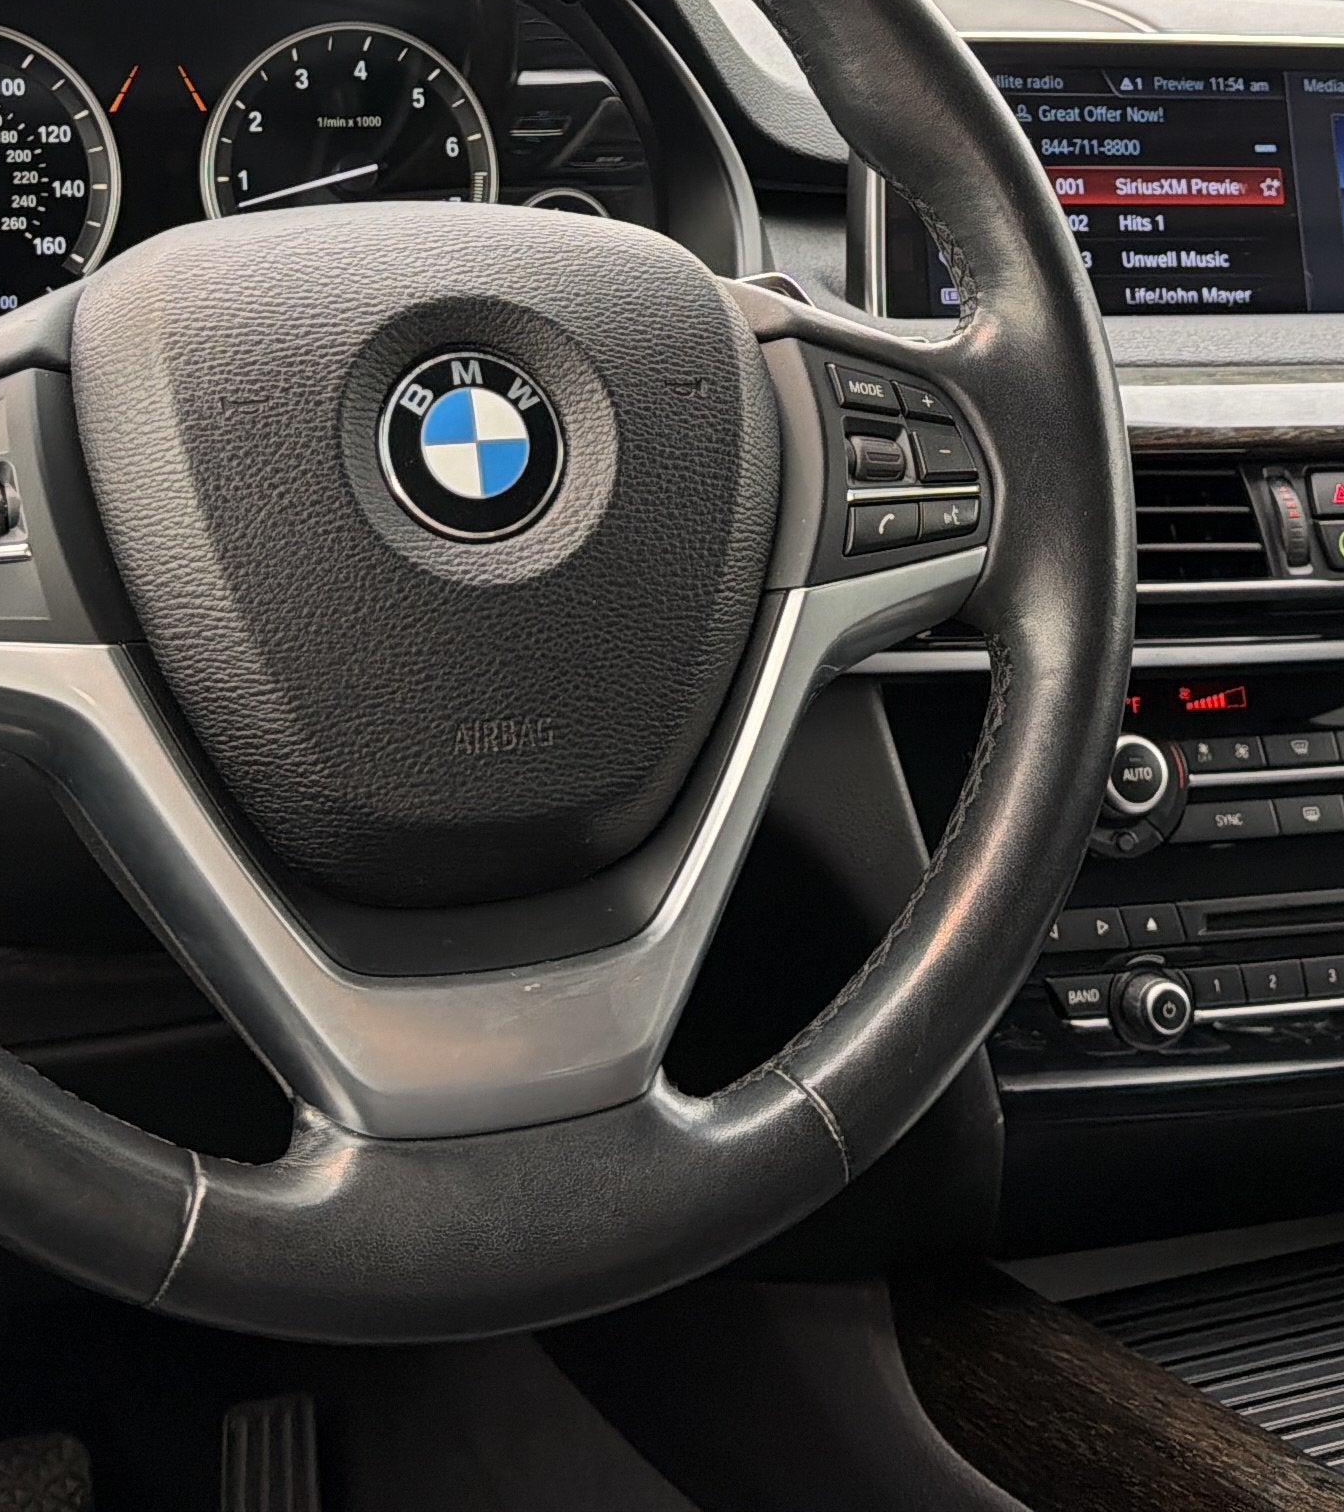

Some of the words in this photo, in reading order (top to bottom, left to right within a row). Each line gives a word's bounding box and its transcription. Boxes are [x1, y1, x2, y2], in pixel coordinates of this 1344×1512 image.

[295, 68, 309, 88] 3
[354, 60, 367, 81] 4
[993, 76, 1023, 88] llite
[1027, 75, 1063, 88] radio
[1135, 78, 1142, 90] 1
[1154, 76, 1204, 91] Preview
[1210, 78, 1244, 91] 11:54
[1250, 81, 1269, 91] am
[412, 88, 425, 108] 5
[248, 111, 262, 131] 2
[317, 116, 345, 127] 1/min
[356, 115, 382, 127] 1000
[1039, 106, 1080, 122] Great
[1084, 106, 1122, 122] Offer
[1127, 107, 1164, 123] Now!
[39, 124, 71, 143] 120
[445, 136, 459, 156] 6
[1042, 139, 1140, 155] 844-711-8800
[6, 149, 32, 162] 200
[13, 171, 39, 183] 220
[238, 170, 248, 189] 1
[52, 179, 85, 197] 140
[1056, 178, 1085, 195] 001
[1115, 178, 1187, 195] SiriusXM
[11, 195, 36, 207] 240
[1, 217, 27, 229] 260
[1066, 215, 1089, 231] 02
[1119, 215, 1152, 231] Hits
[1156, 216, 1164, 231] 1
[34, 236, 66, 254] 160
[1122, 251, 1177, 268] Unwell
[1181, 251, 1230, 268] Music
[1125, 287, 1198, 304] Life/John
[1202, 289, 1252, 307] Mayer
[400, 360, 541, 417] BMW
[848, 380, 884, 397] MODE
[454, 717, 554, 756] AIRBAG
[1123, 767, 1152, 781] AUTO
[1215, 813, 1244, 827] SYNC
[1213, 979, 1220, 992] 1
[1268, 975, 1277, 989] 2
[1328, 969, 1337, 983] 3
[1068, 988, 1100, 1004] BAND
